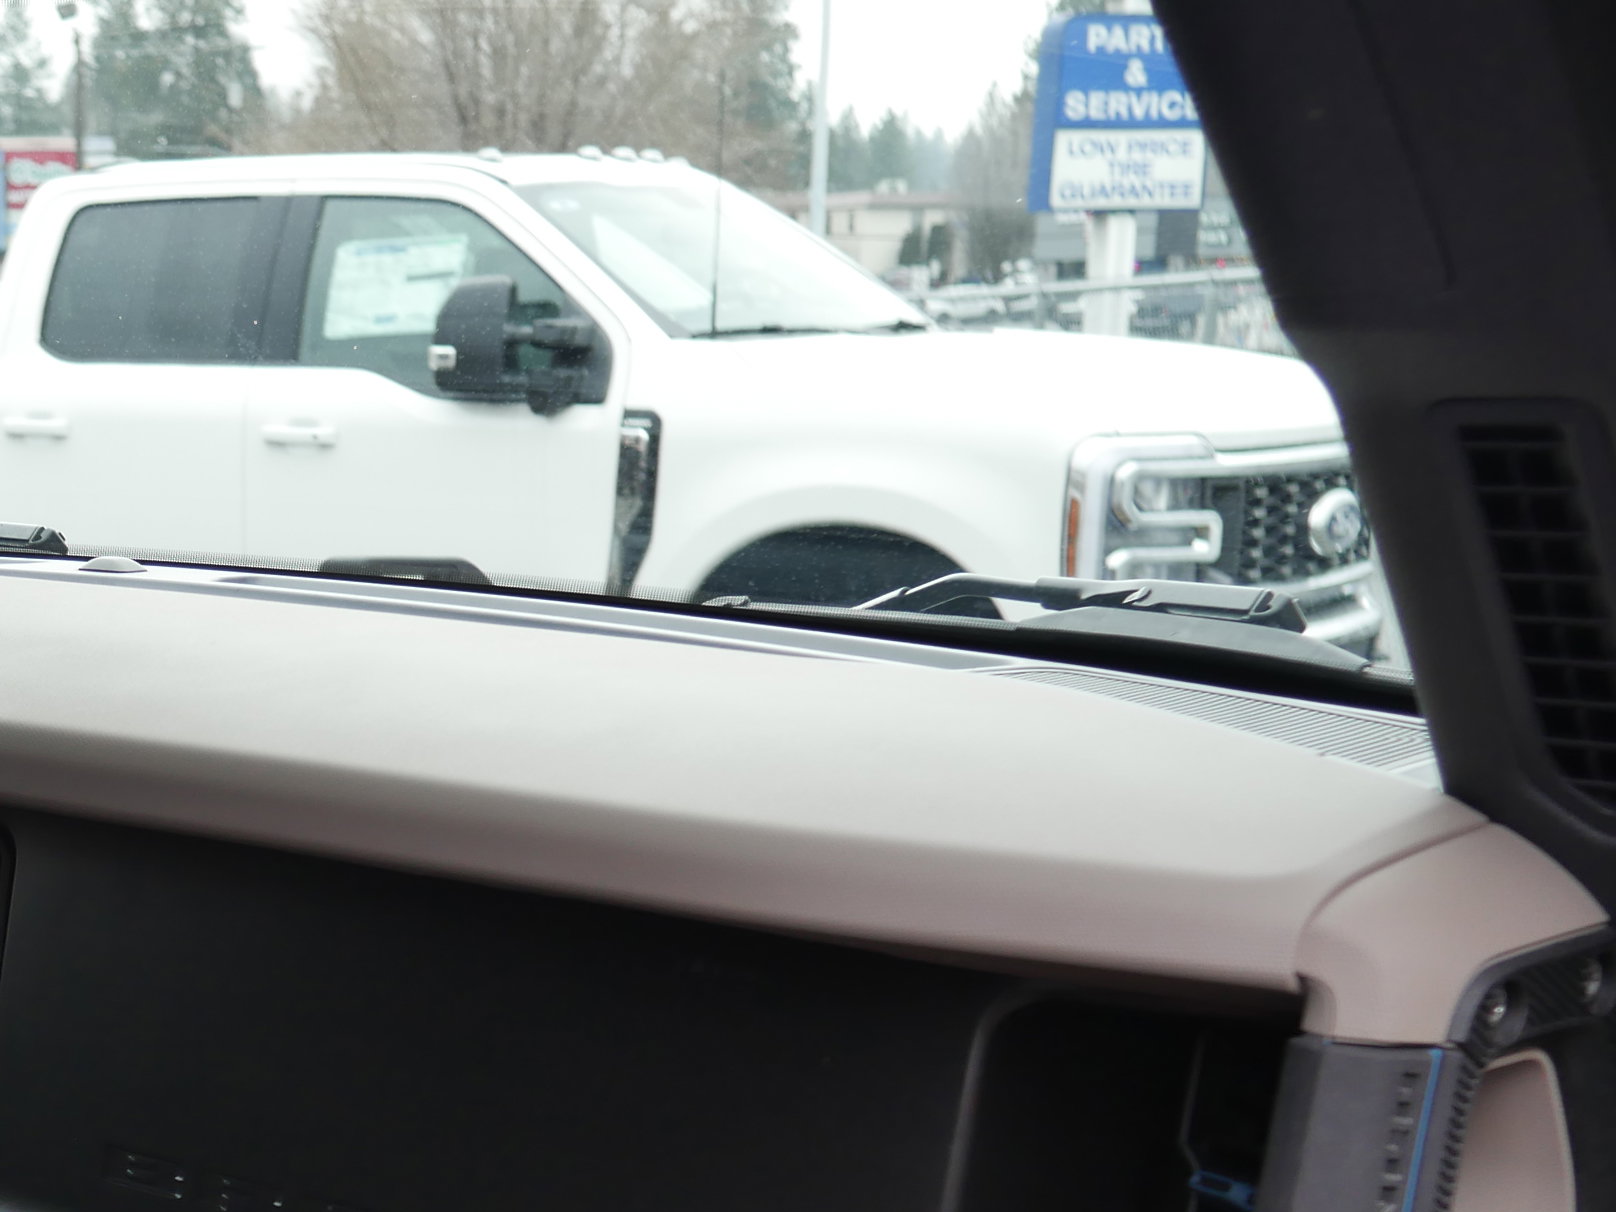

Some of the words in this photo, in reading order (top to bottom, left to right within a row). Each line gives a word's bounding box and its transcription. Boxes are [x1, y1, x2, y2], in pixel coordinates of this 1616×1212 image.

[1124, 57, 1148, 88] &
[1068, 137, 1120, 156] LOW
[1128, 137, 1192, 157] PRICE
[1108, 161, 1152, 177] TIRE
[1059, 181, 1193, 201] GUARANTEE
